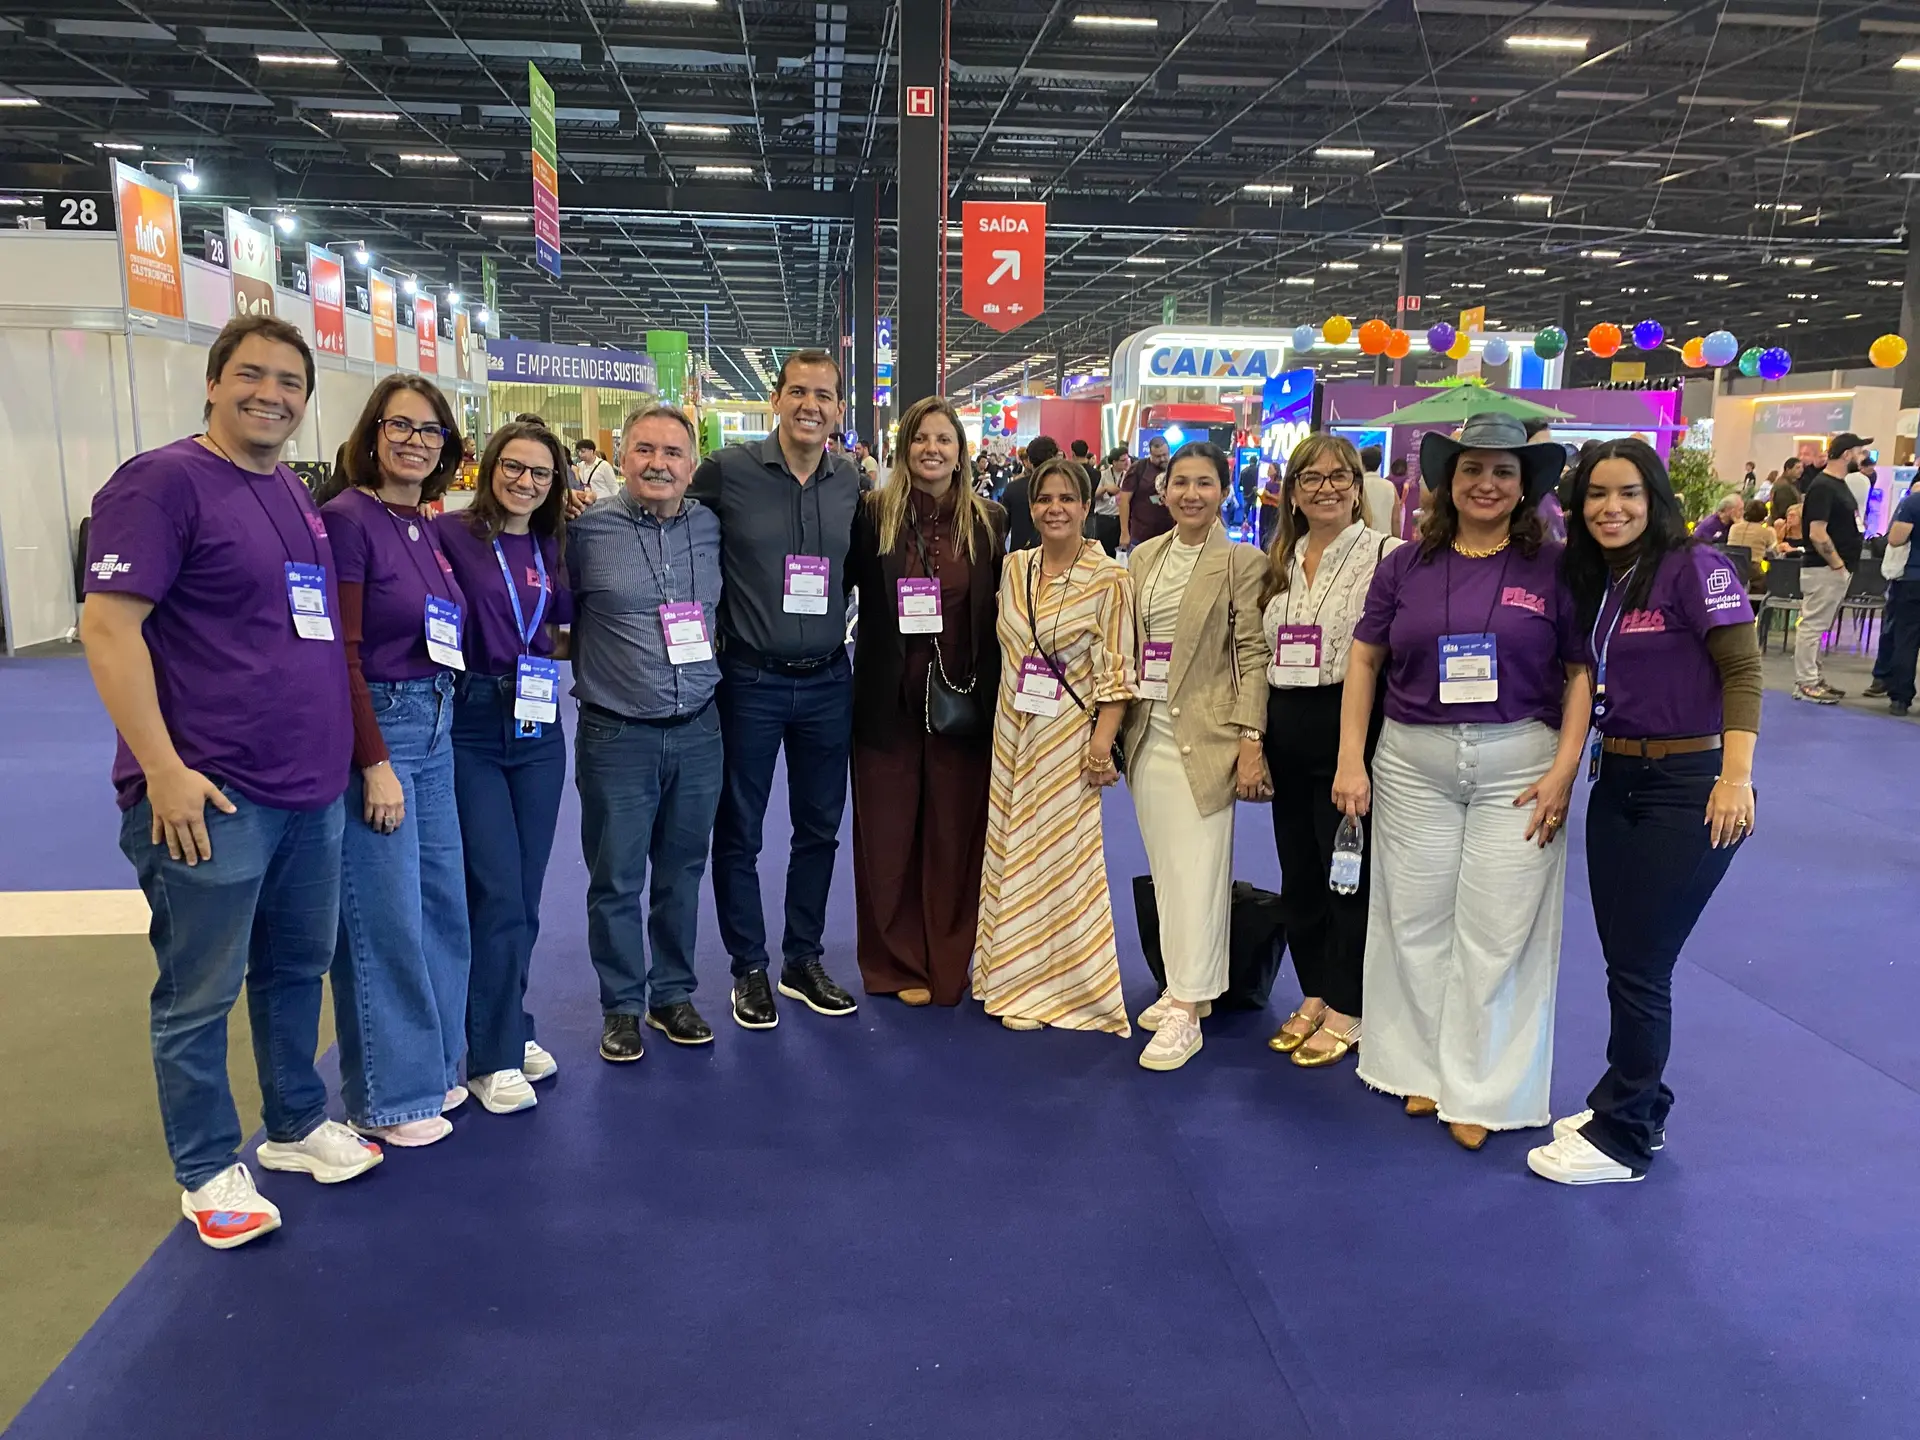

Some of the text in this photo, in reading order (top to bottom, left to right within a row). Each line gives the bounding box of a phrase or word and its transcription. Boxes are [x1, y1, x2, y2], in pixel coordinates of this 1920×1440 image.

[911, 91, 930, 113] H
[60, 198, 98, 226] 28
[979, 215, 1029, 233] SAÍDA
[211, 238, 224, 264] 28
[297, 269, 307, 291] 29
[1150, 347, 1269, 377] CAIXA
[90, 562, 132, 572] SEBRAE
[1705, 593, 1741, 605] faculdade
[1716, 600, 1741, 610] sebrae
